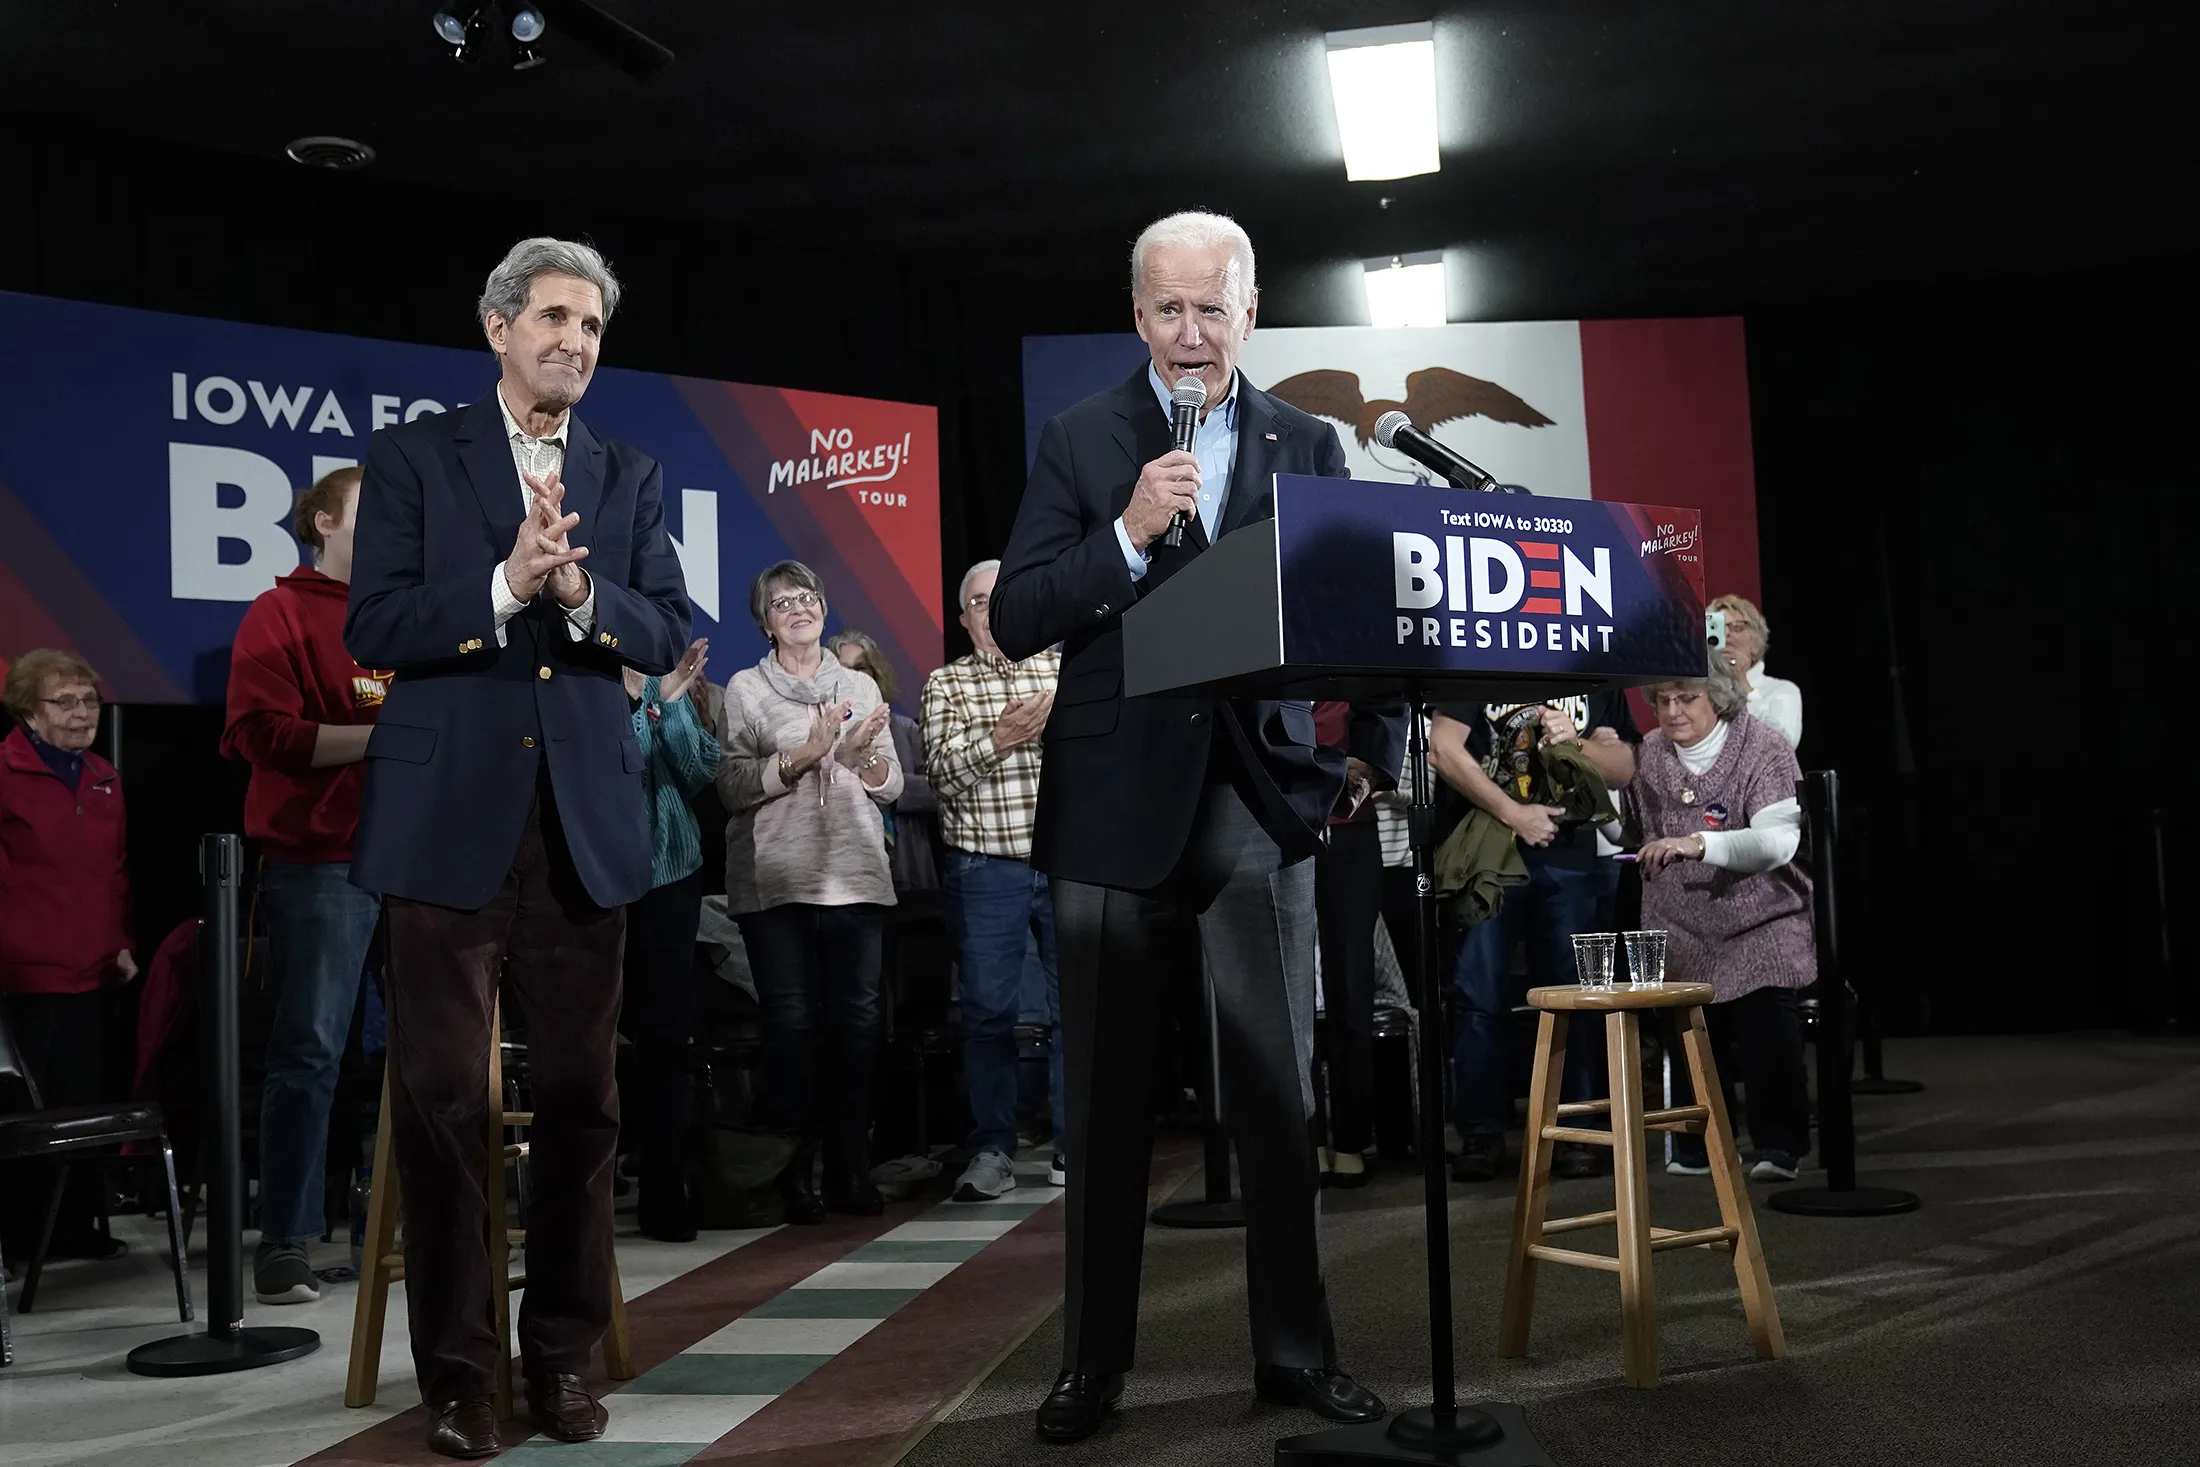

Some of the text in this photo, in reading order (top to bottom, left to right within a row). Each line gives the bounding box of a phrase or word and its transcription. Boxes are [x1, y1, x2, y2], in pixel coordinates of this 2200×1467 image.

[172, 372, 355, 437] IOWA
[811, 428, 854, 454] NO
[768, 432, 912, 494] MALARKEY!
[859, 490, 908, 507] TOUR
[1440, 509, 1573, 534] Text IOWA to 30330
[1657, 524, 1675, 538] NO
[1641, 525, 1698, 558] MALARKEY!
[1677, 554, 1698, 562] TOUR
[1393, 532, 1613, 618] BIDEN
[1397, 616, 1613, 652] PRESIDENT
